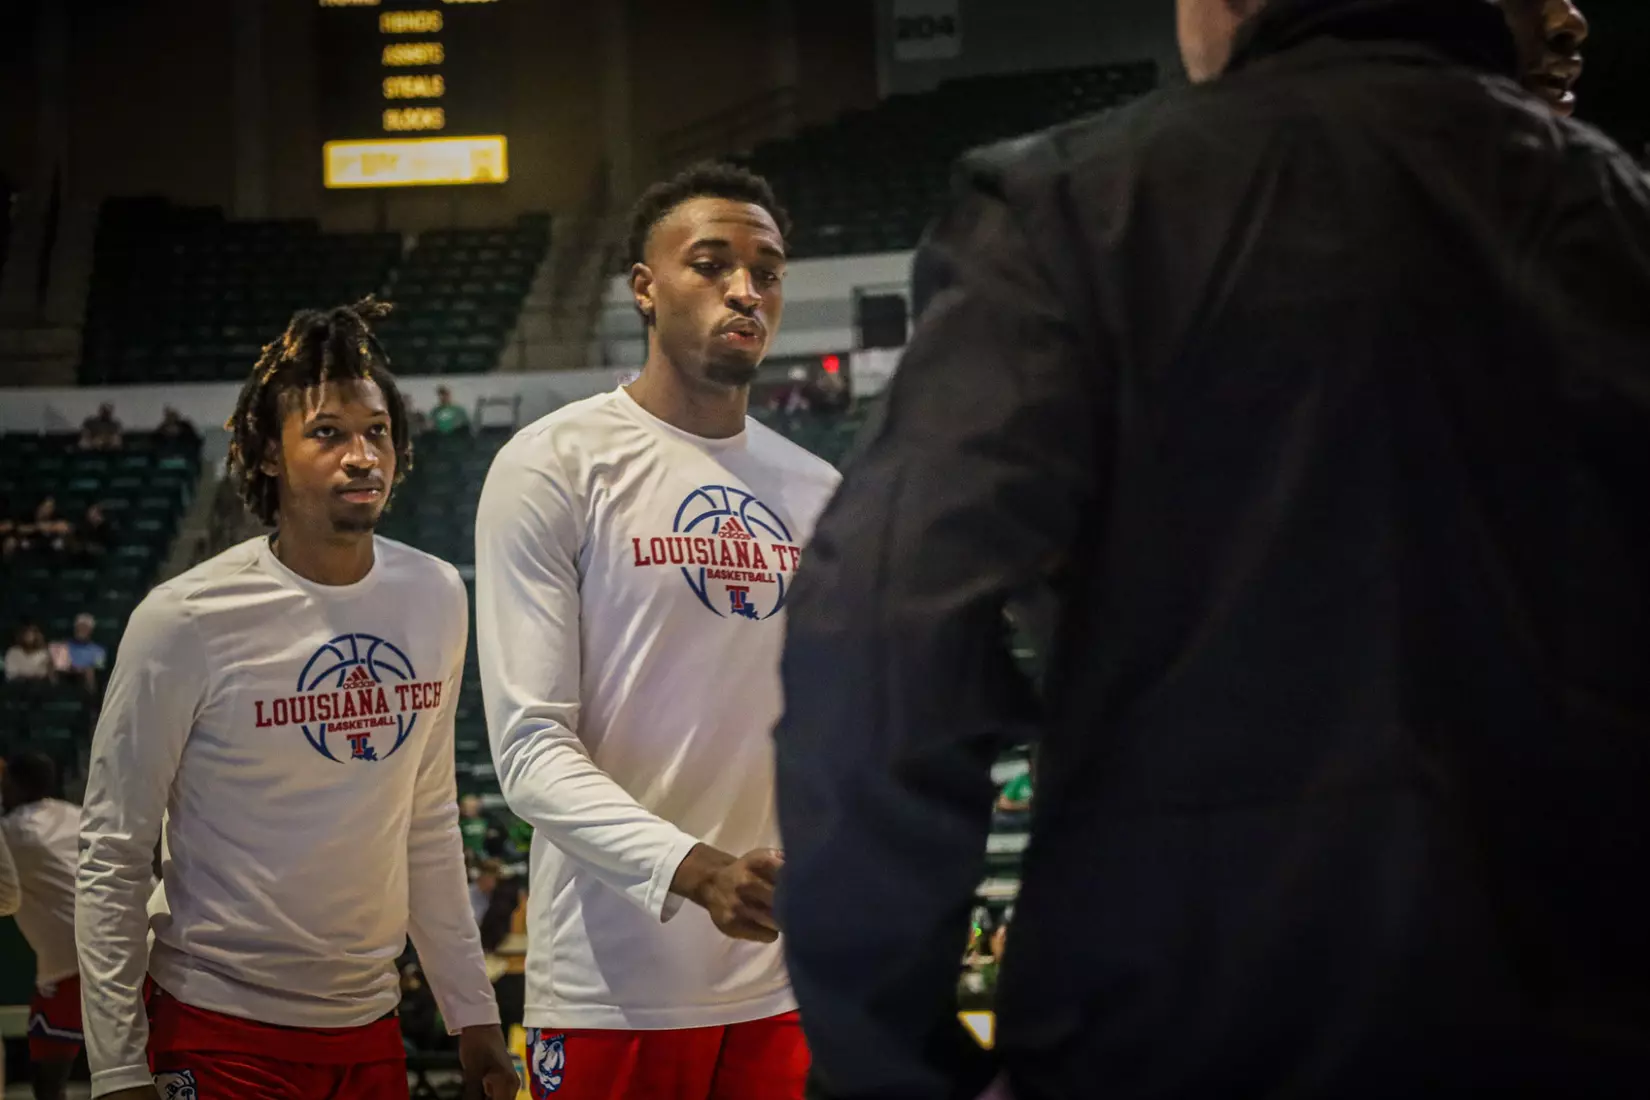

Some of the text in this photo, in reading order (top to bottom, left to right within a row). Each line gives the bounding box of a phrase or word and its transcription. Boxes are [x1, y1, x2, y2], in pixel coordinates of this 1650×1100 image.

[897, 14, 955, 40] 204
[382, 42, 444, 66] ASSISTS
[383, 74, 445, 99] STEALS
[383, 107, 445, 131] BLOCKS
[718, 530, 751, 540] adidas
[632, 537, 768, 569] LOUISIANA
[706, 568, 776, 583] BASKETBALL
[342, 679, 376, 690] adidas
[255, 681, 442, 727] LOUISIANA TECH
[328, 715, 396, 732] BASKETBALL
